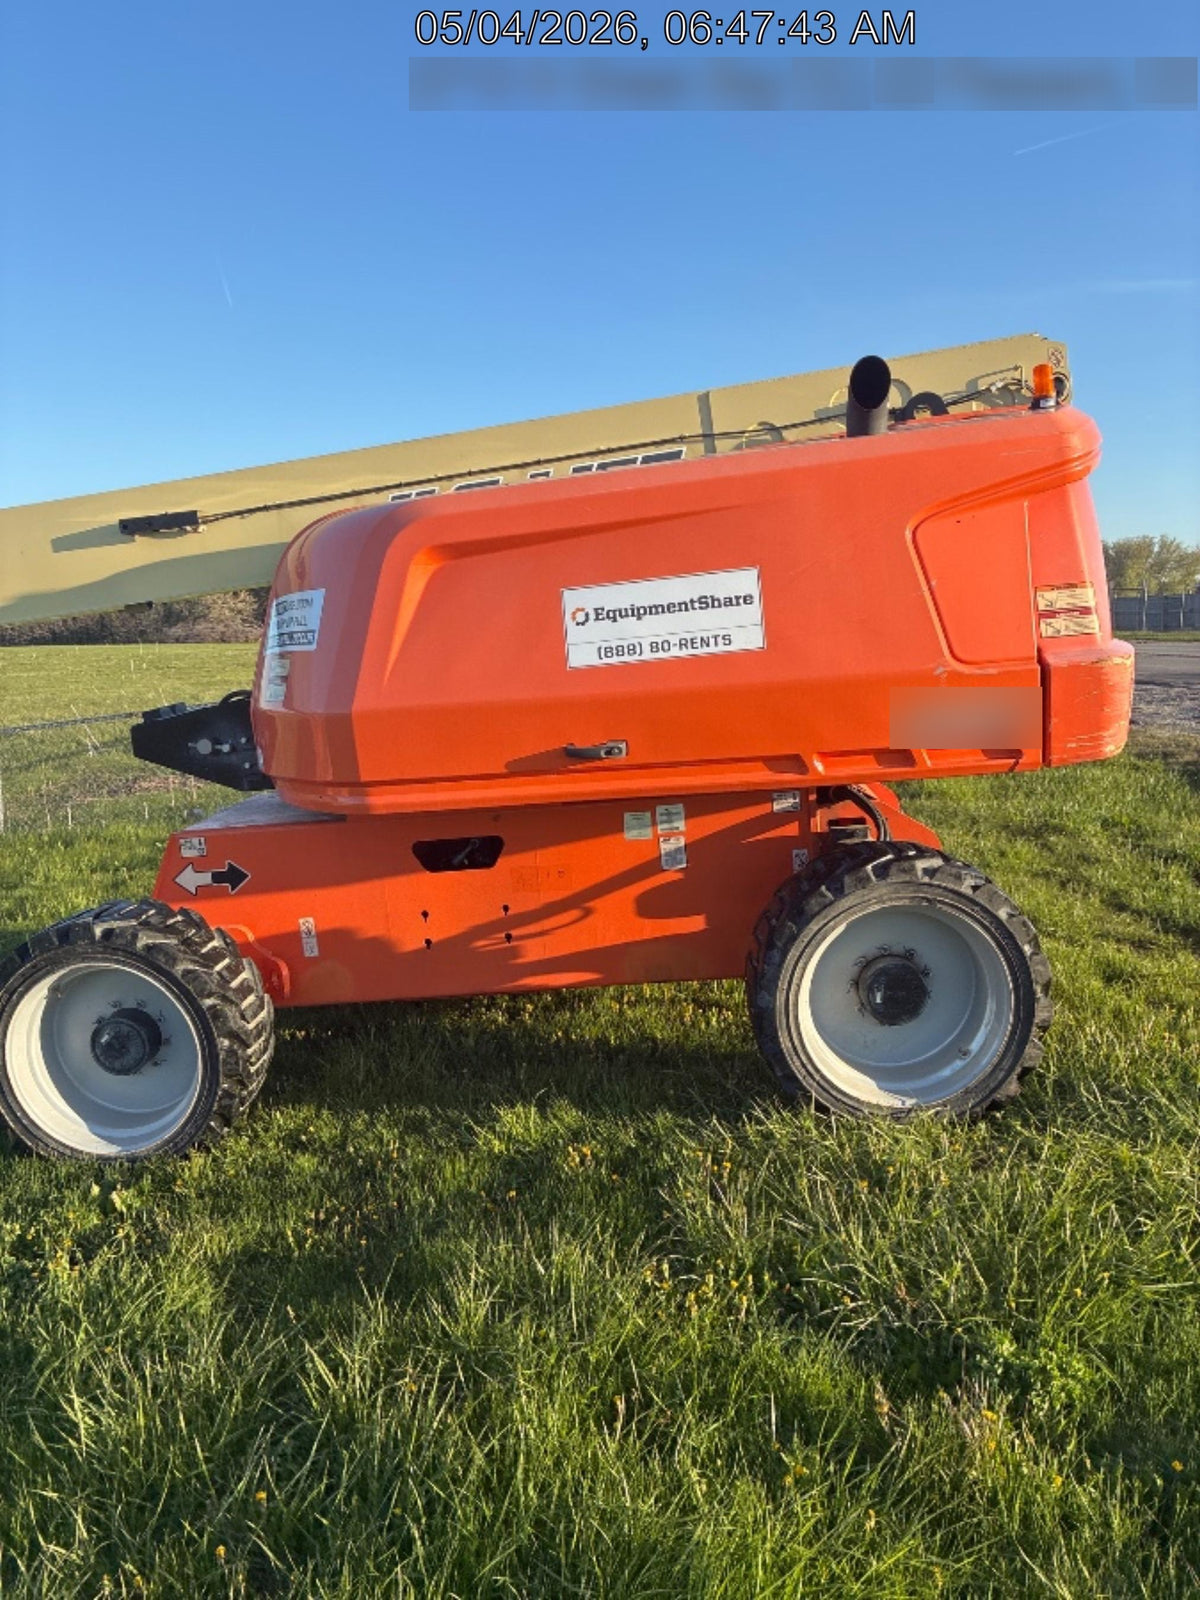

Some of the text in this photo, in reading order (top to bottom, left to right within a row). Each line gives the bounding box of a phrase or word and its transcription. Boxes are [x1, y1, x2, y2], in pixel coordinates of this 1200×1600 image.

[593, 593, 754, 623] EquipmentShare
[597, 634, 732, 660] (888) 80-RENTS
